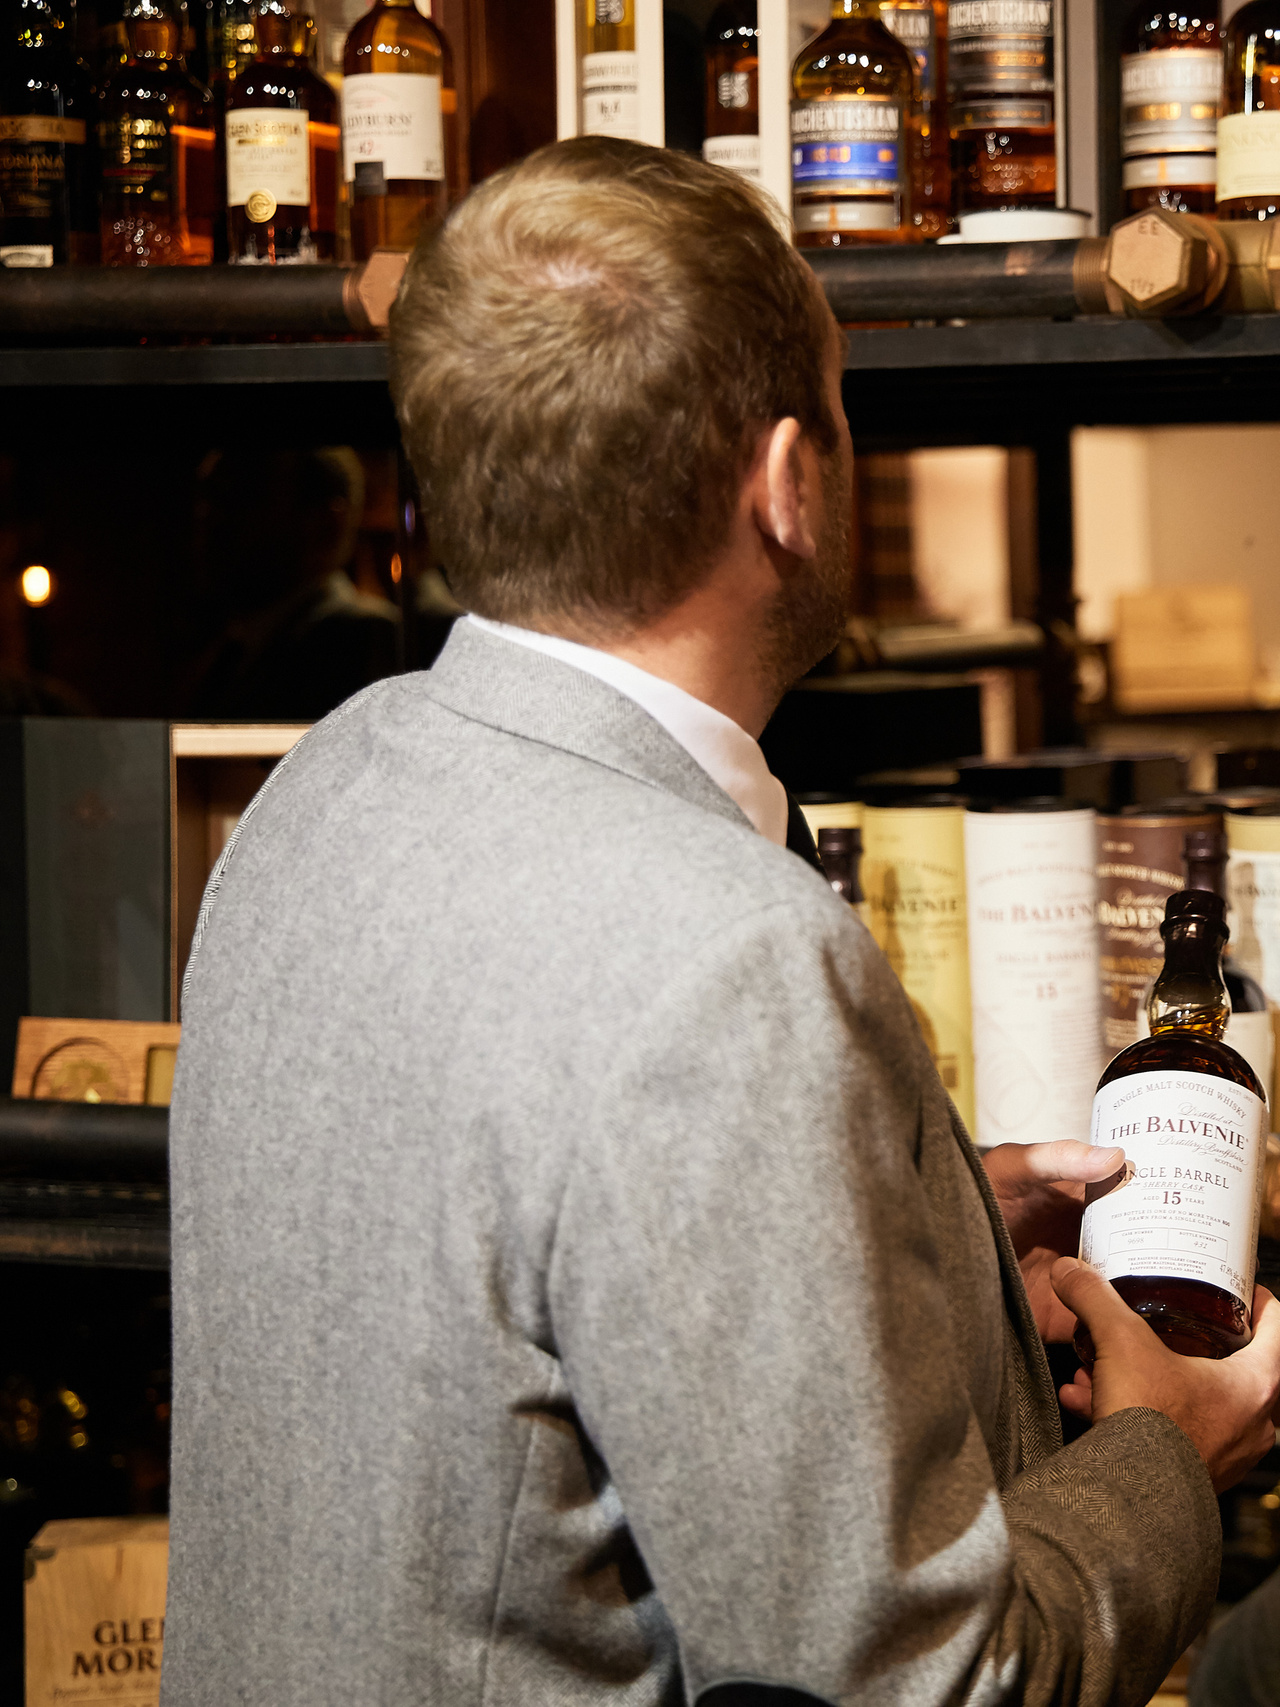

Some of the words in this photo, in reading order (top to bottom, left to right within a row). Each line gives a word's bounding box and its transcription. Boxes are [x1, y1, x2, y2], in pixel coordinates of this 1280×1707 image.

[1113, 1086, 1144, 1111] SINGLE
[1145, 1081, 1173, 1093] MALT
[1175, 1080, 1215, 1097] SCOTCH
[1216, 1091, 1247, 1120] WHISKY
[1178, 1101, 1224, 1121] Distilled
[1110, 1122, 1142, 1141] THE
[1146, 1116, 1247, 1150] BALVENIE
[1214, 1157, 1243, 1173] SCOTLAND
[1116, 1167, 1167, 1183] SINGLE
[1174, 1166, 1230, 1190] BARREL
[1143, 1181, 1180, 1189] SHERRY
[1181, 1182, 1206, 1192] CASK
[1162, 1190, 1182, 1206] 15
[1185, 1197, 1205, 1205] YEARS
[1123, 1209, 1145, 1217] BOTTLE
[94, 1618, 164, 1646] GLE
[72, 1647, 161, 1677] MOR
